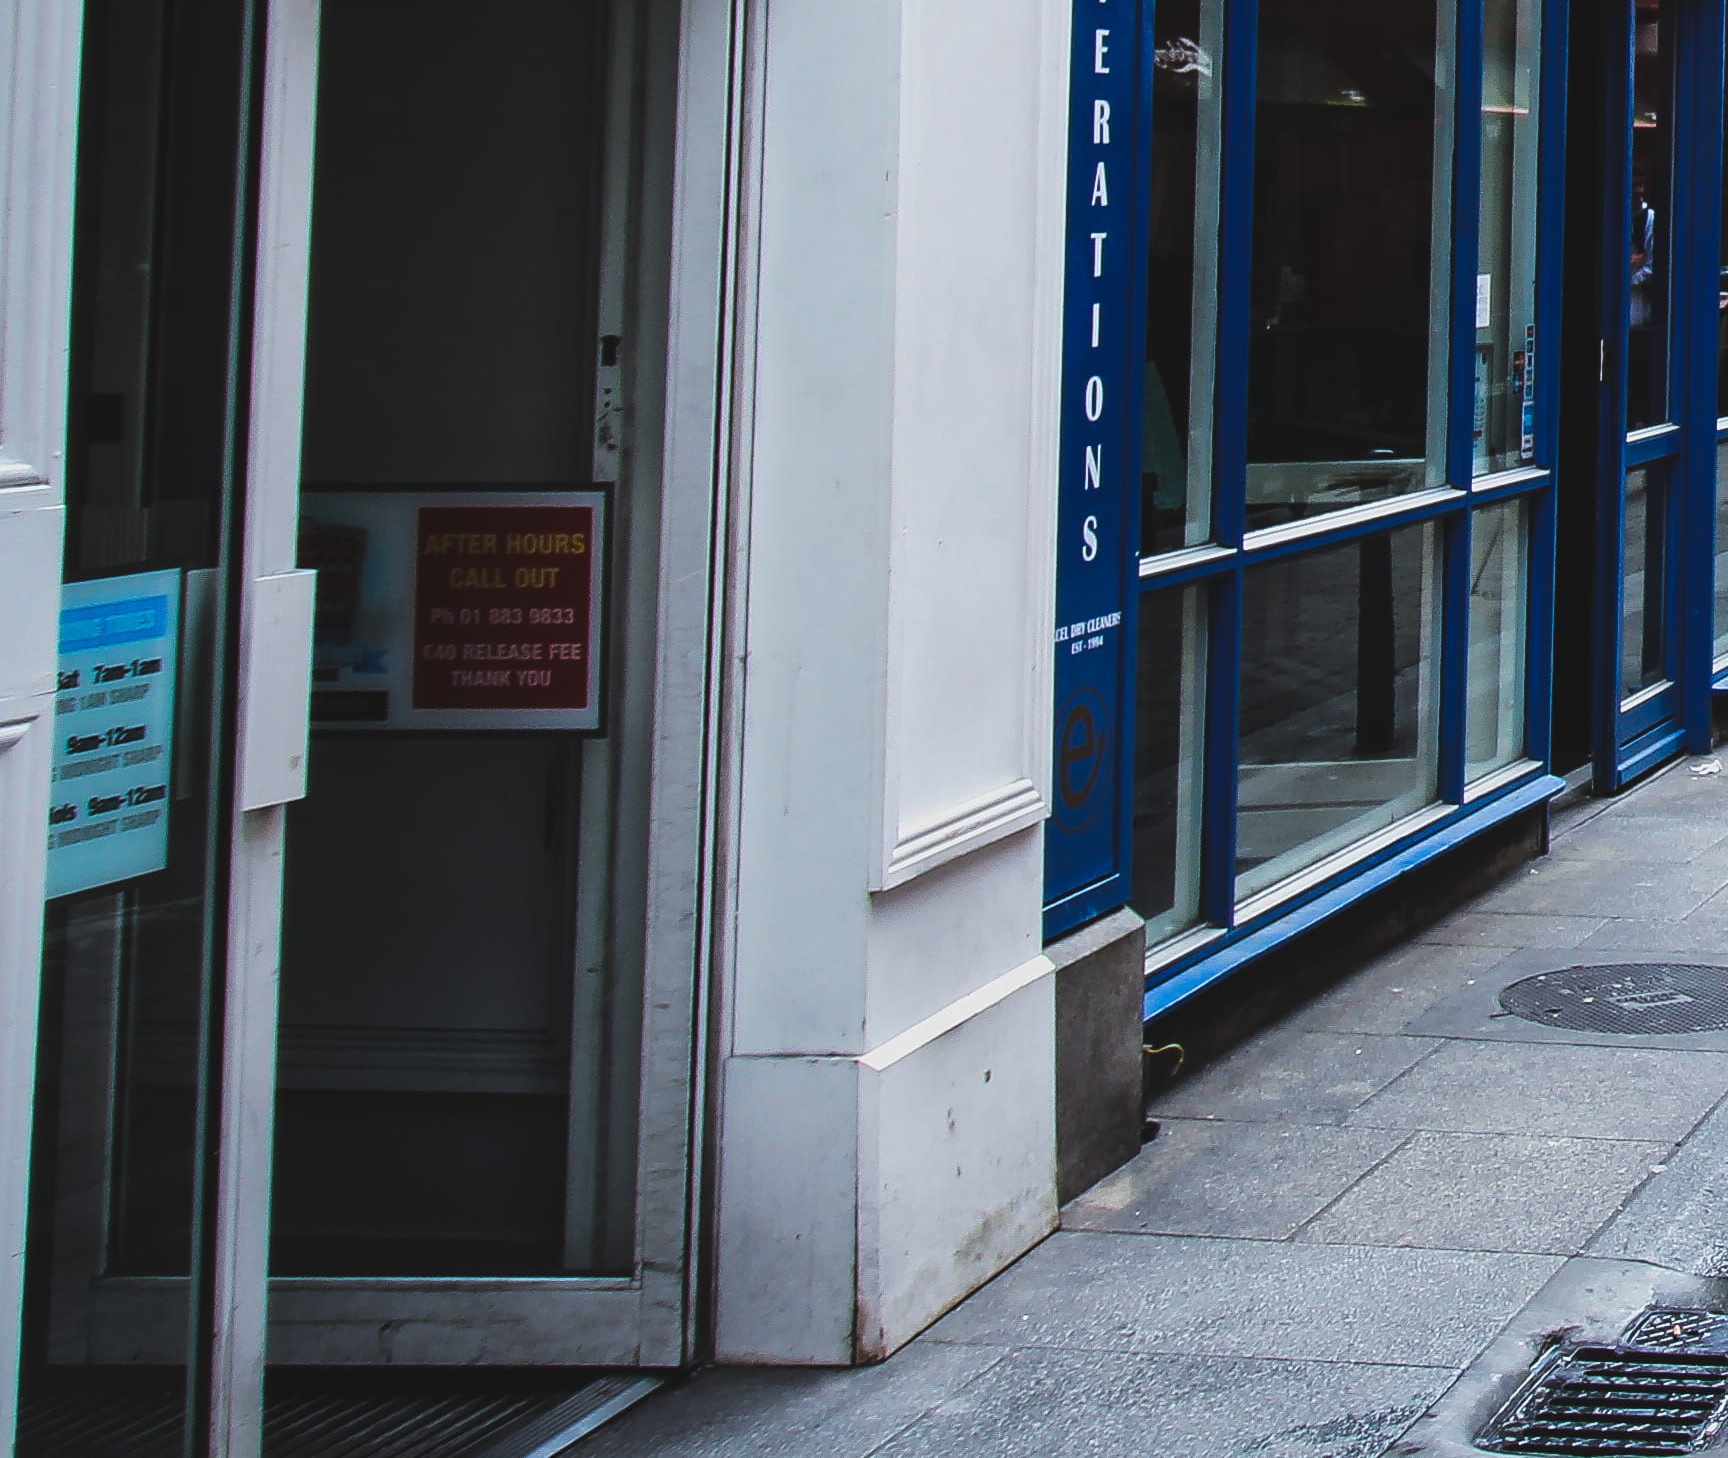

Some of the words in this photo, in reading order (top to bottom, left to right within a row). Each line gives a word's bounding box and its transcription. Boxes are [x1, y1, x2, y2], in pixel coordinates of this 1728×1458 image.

[423, 533, 497, 557] AFTER
[504, 533, 587, 556] HOURS
[449, 567, 508, 589] CALL
[514, 567, 561, 589] OUT
[460, 607, 482, 625] 01
[462, 643, 544, 661] RELEASE
[548, 643, 583, 661] FEE
[450, 669, 511, 688] THANK
[517, 669, 553, 688] YOU
